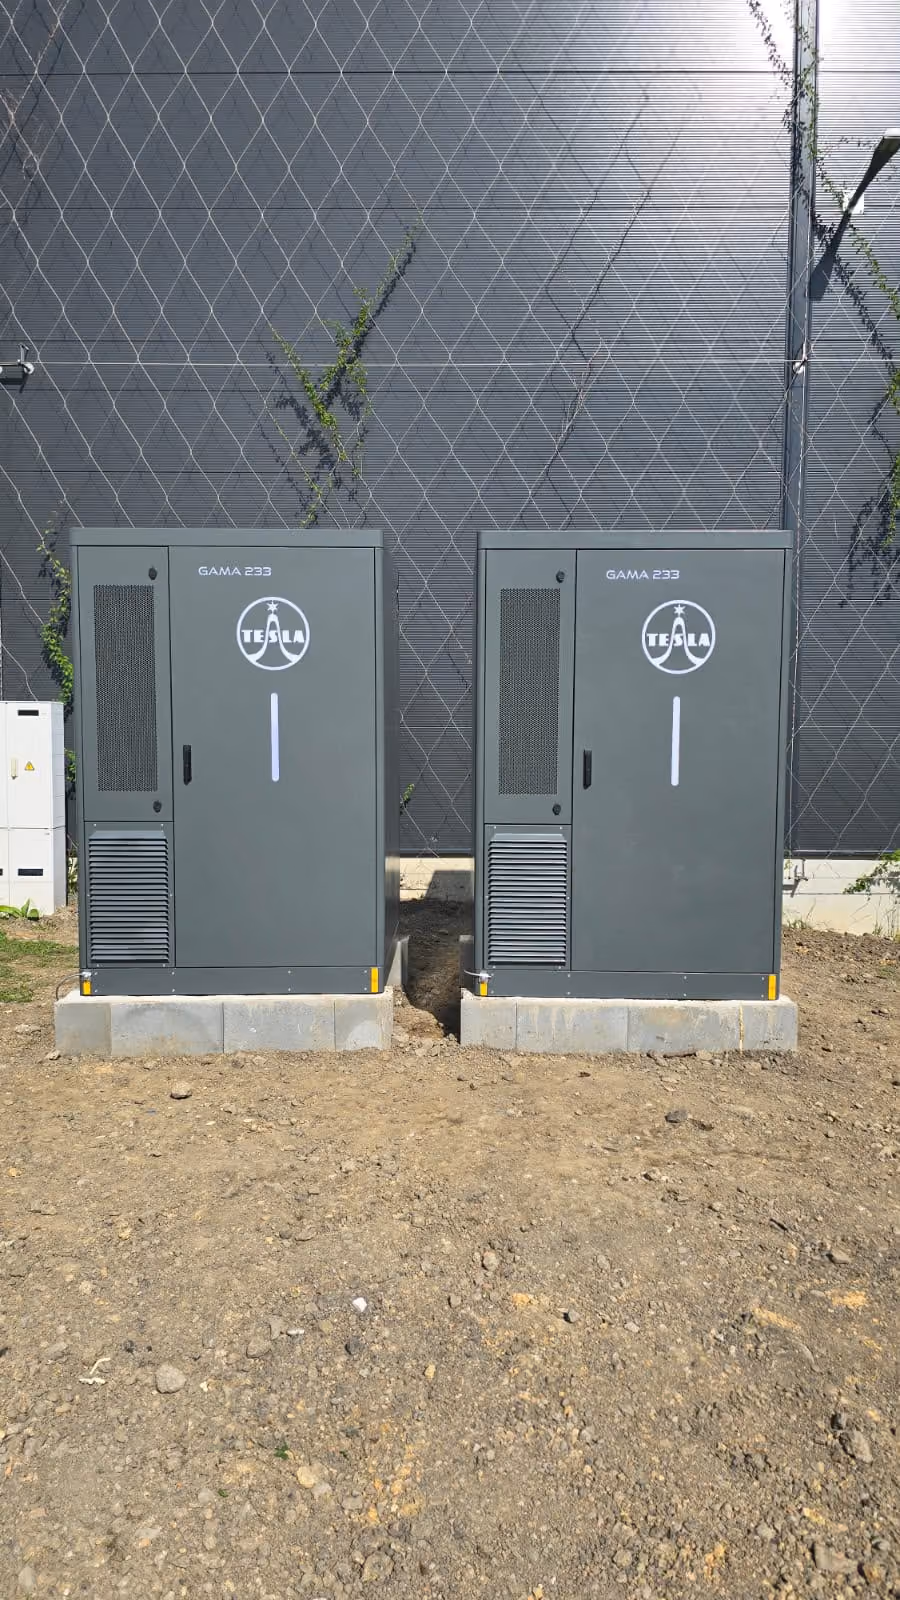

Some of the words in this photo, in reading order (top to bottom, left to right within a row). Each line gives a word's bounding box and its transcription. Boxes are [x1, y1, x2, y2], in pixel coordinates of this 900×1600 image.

[198, 566, 242, 576] GAMA
[244, 566, 272, 576] 233
[606, 569, 650, 580] GAMA
[652, 569, 680, 580] 233
[241, 629, 305, 643] TESLA
[646, 633, 711, 647] TESLA
